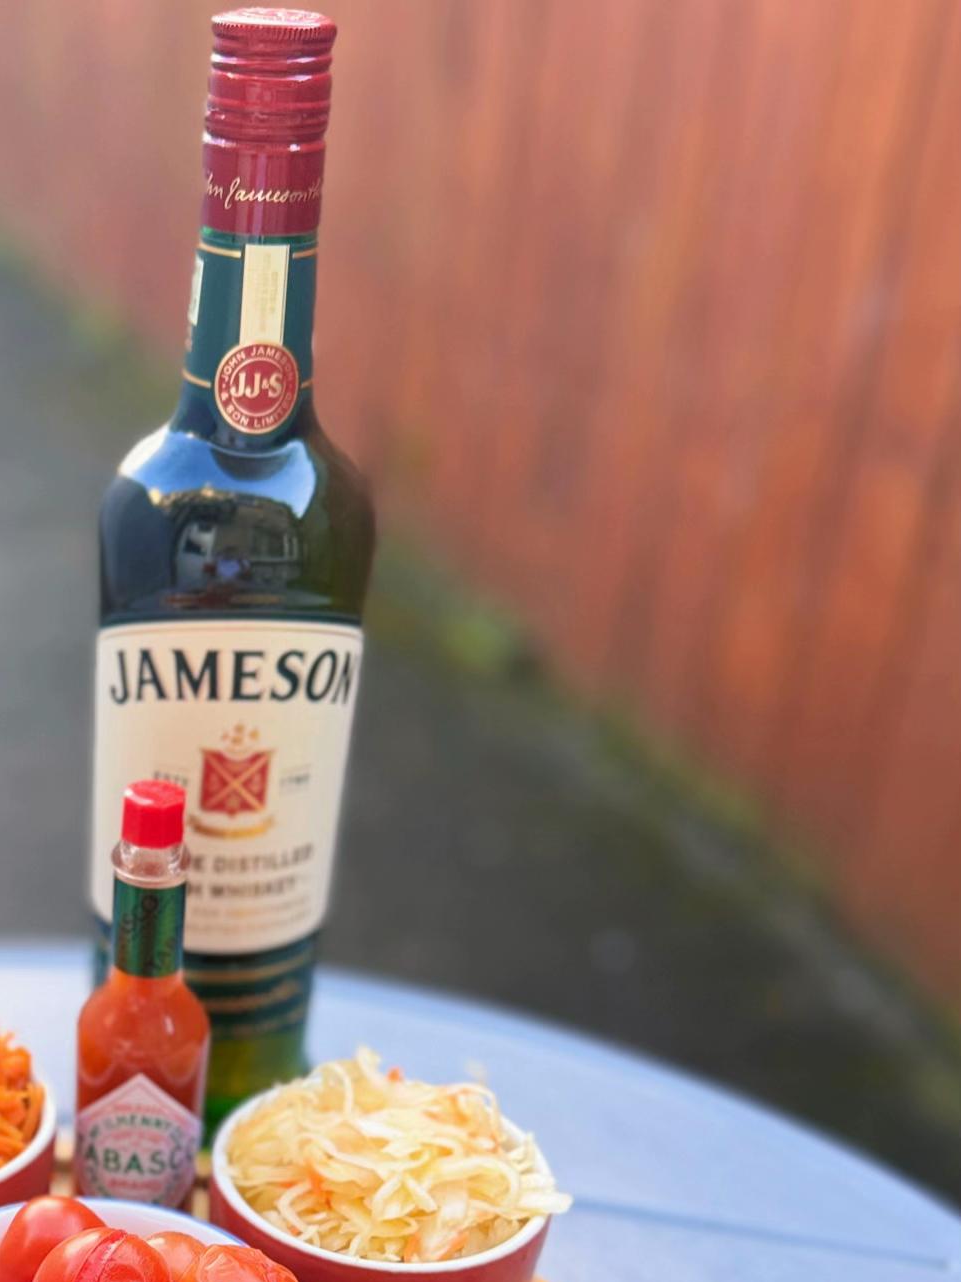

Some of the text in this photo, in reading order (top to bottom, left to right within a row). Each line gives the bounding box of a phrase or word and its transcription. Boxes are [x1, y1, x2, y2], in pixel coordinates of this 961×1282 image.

[222, 351, 246, 382] JOHN
[230, 371, 283, 398] JJ&S
[110, 649, 357, 705] JAMESON
